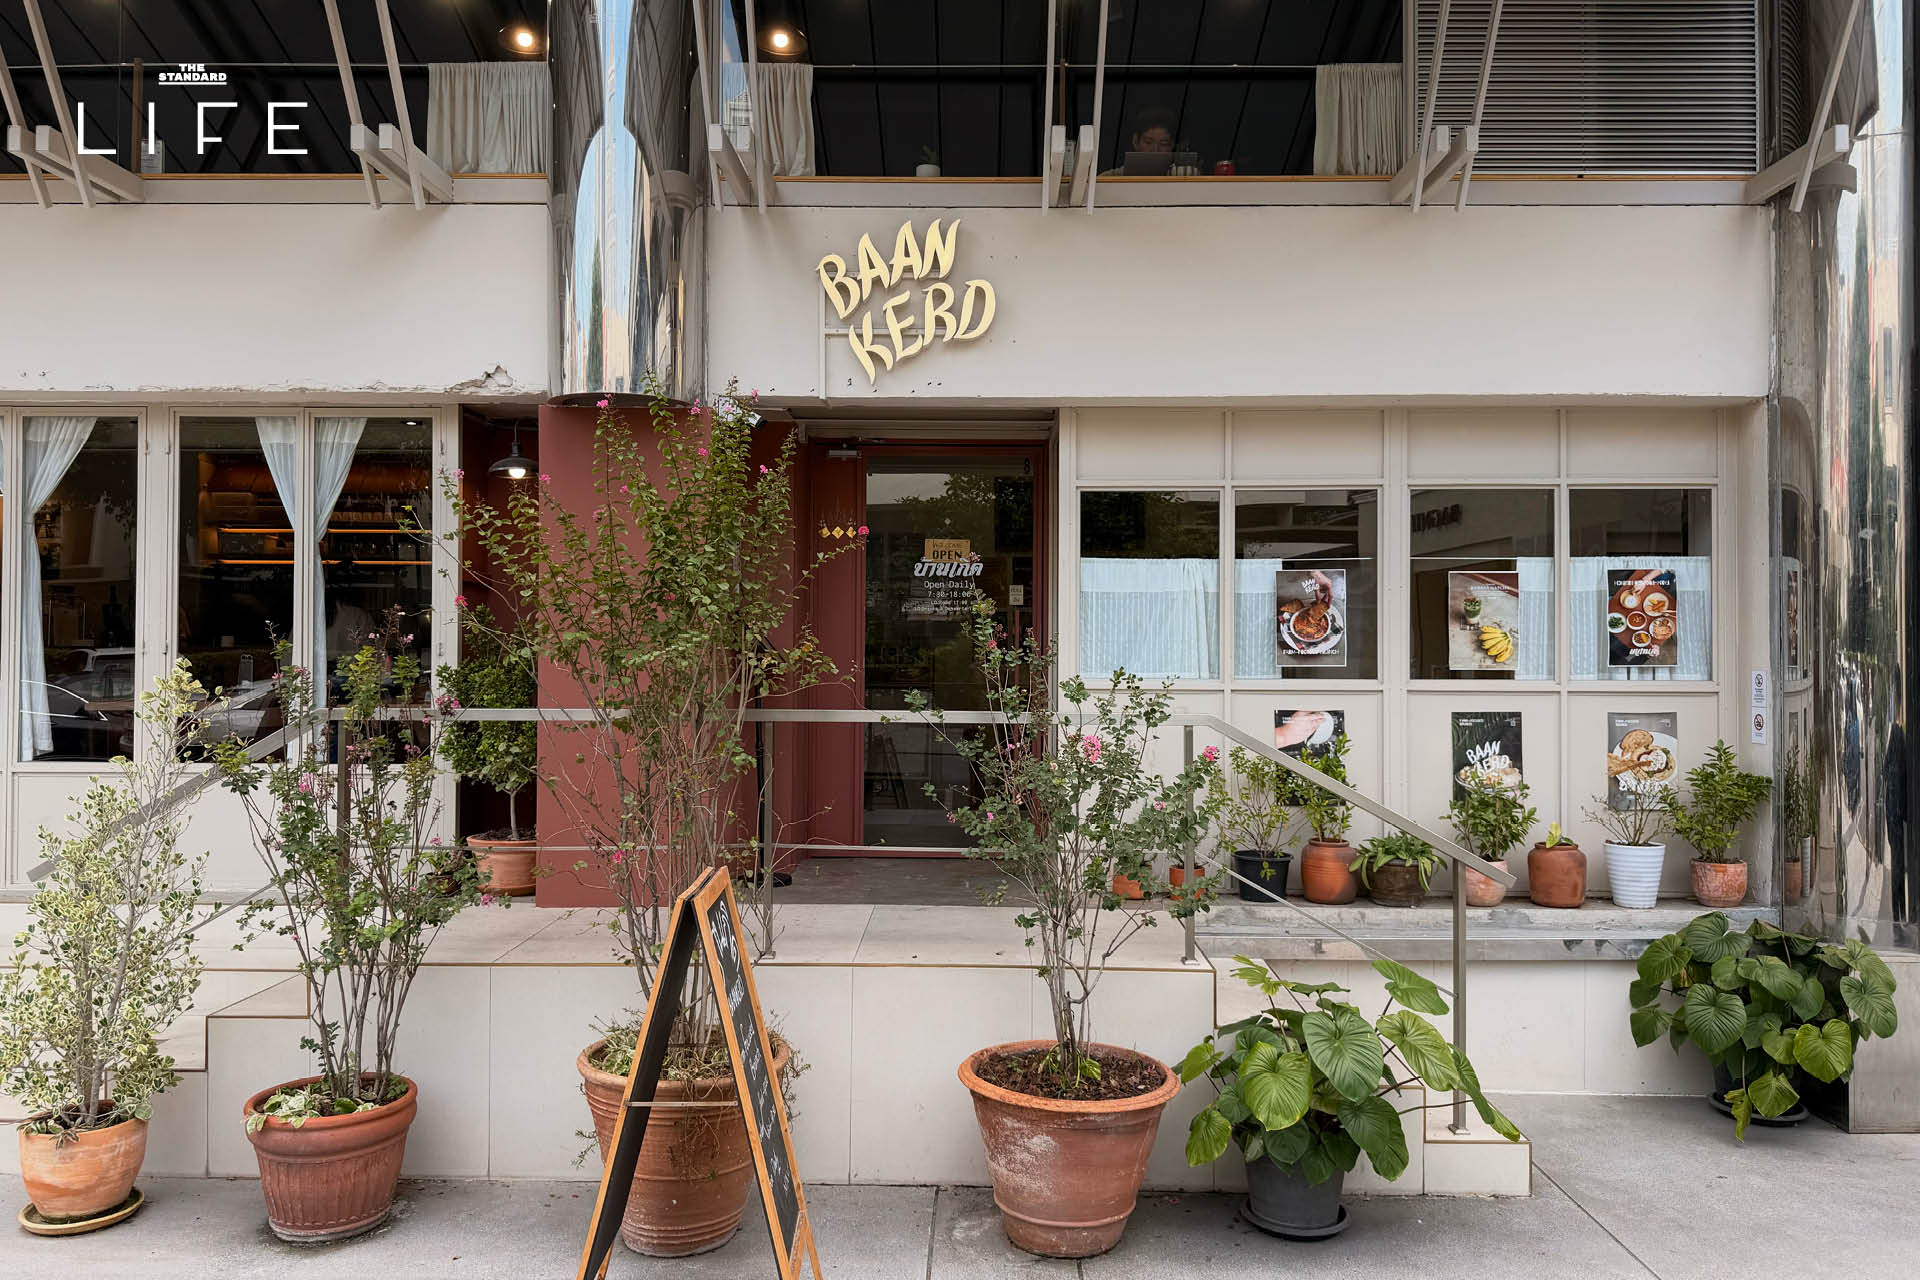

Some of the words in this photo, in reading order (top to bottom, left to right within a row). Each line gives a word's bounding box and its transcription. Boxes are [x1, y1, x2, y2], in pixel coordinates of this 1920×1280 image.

[816, 218, 961, 320] BAAN
[849, 279, 996, 385] KERD
[932, 550, 962, 560] OPEN
[924, 580, 945, 590] Open
[948, 580, 974, 590] Daily
[1465, 740, 1501, 764] BAAN
